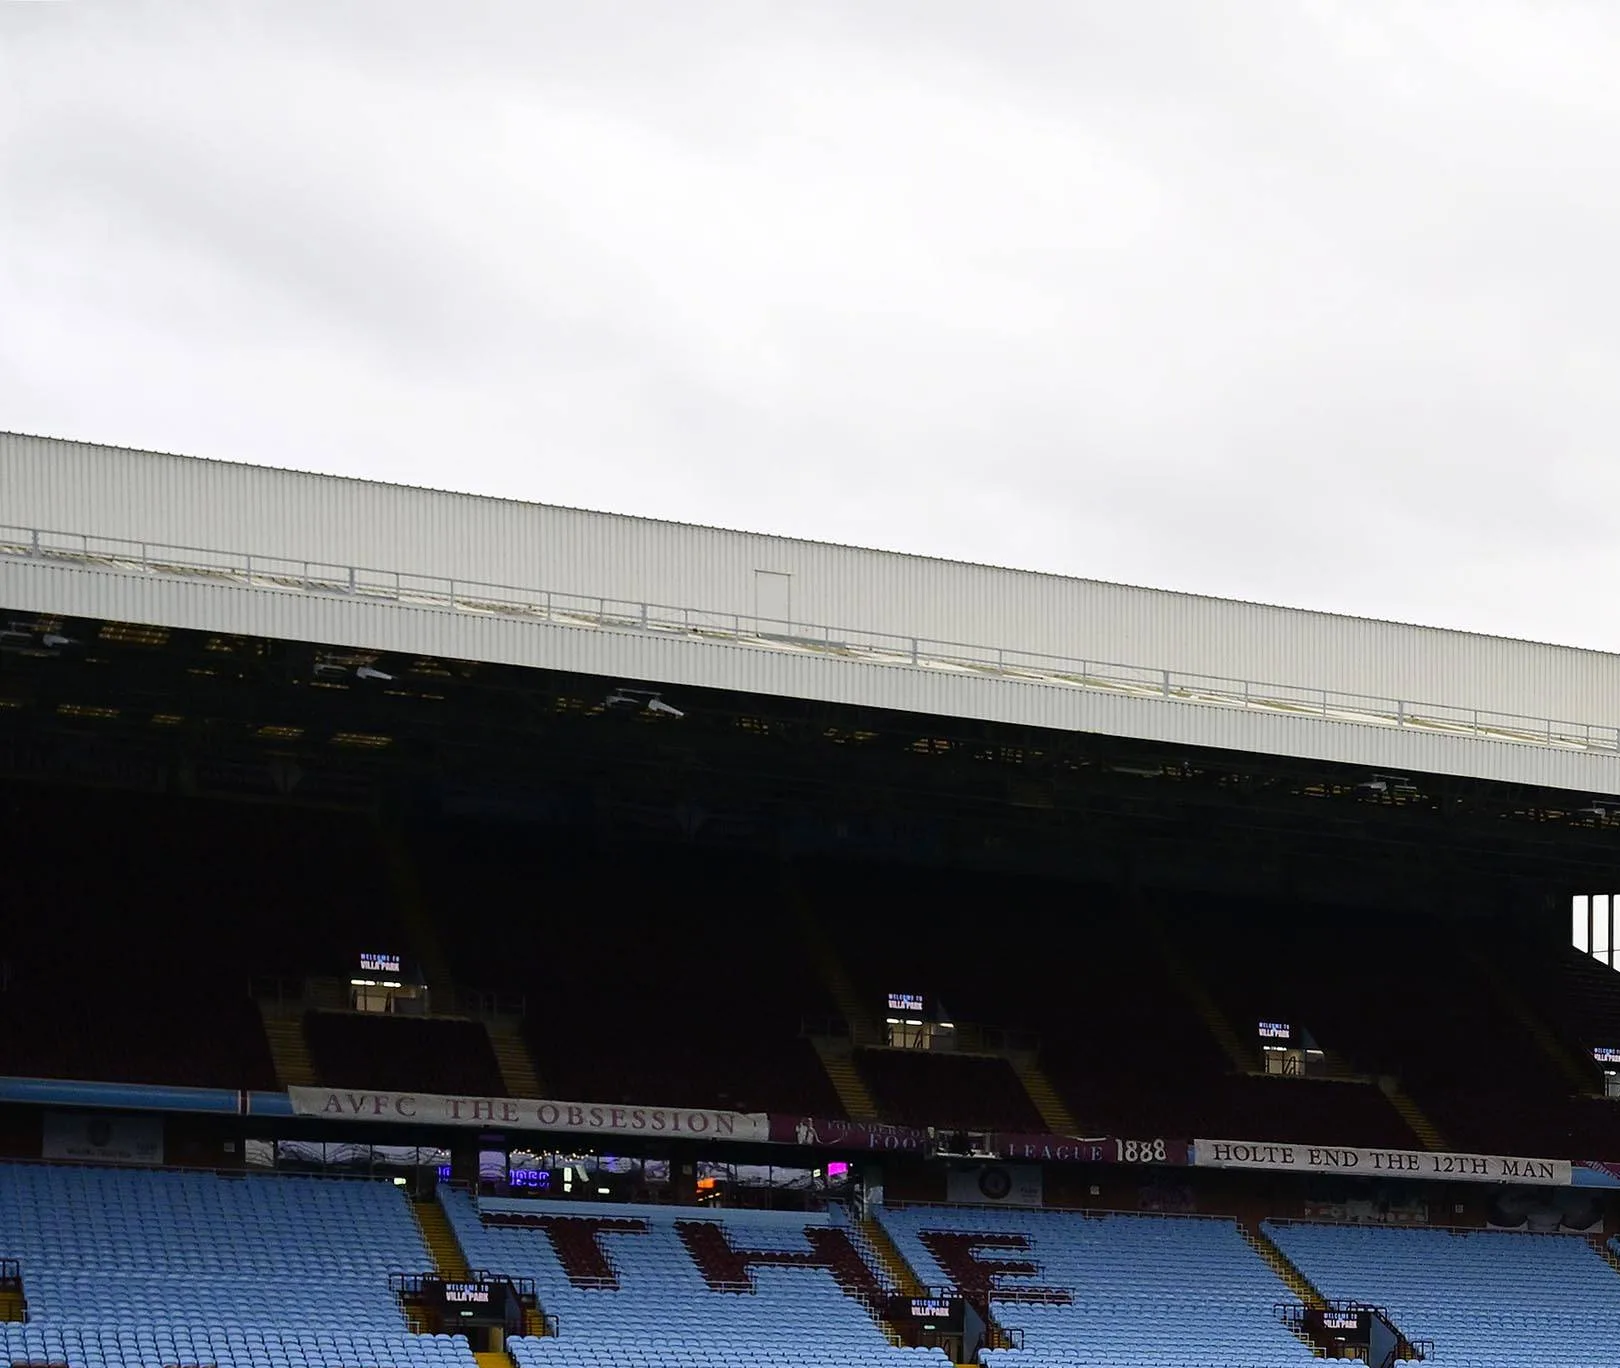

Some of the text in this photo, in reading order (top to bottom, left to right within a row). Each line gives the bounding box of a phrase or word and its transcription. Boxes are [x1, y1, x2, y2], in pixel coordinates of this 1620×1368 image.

[322, 1093, 736, 1136] AVFC THE OBSESSION
[1115, 1138, 1168, 1164] 1888
[1213, 1142, 1555, 1180] HOLTE END THE 12TH MAN
[480, 1212, 1075, 1304] THE
